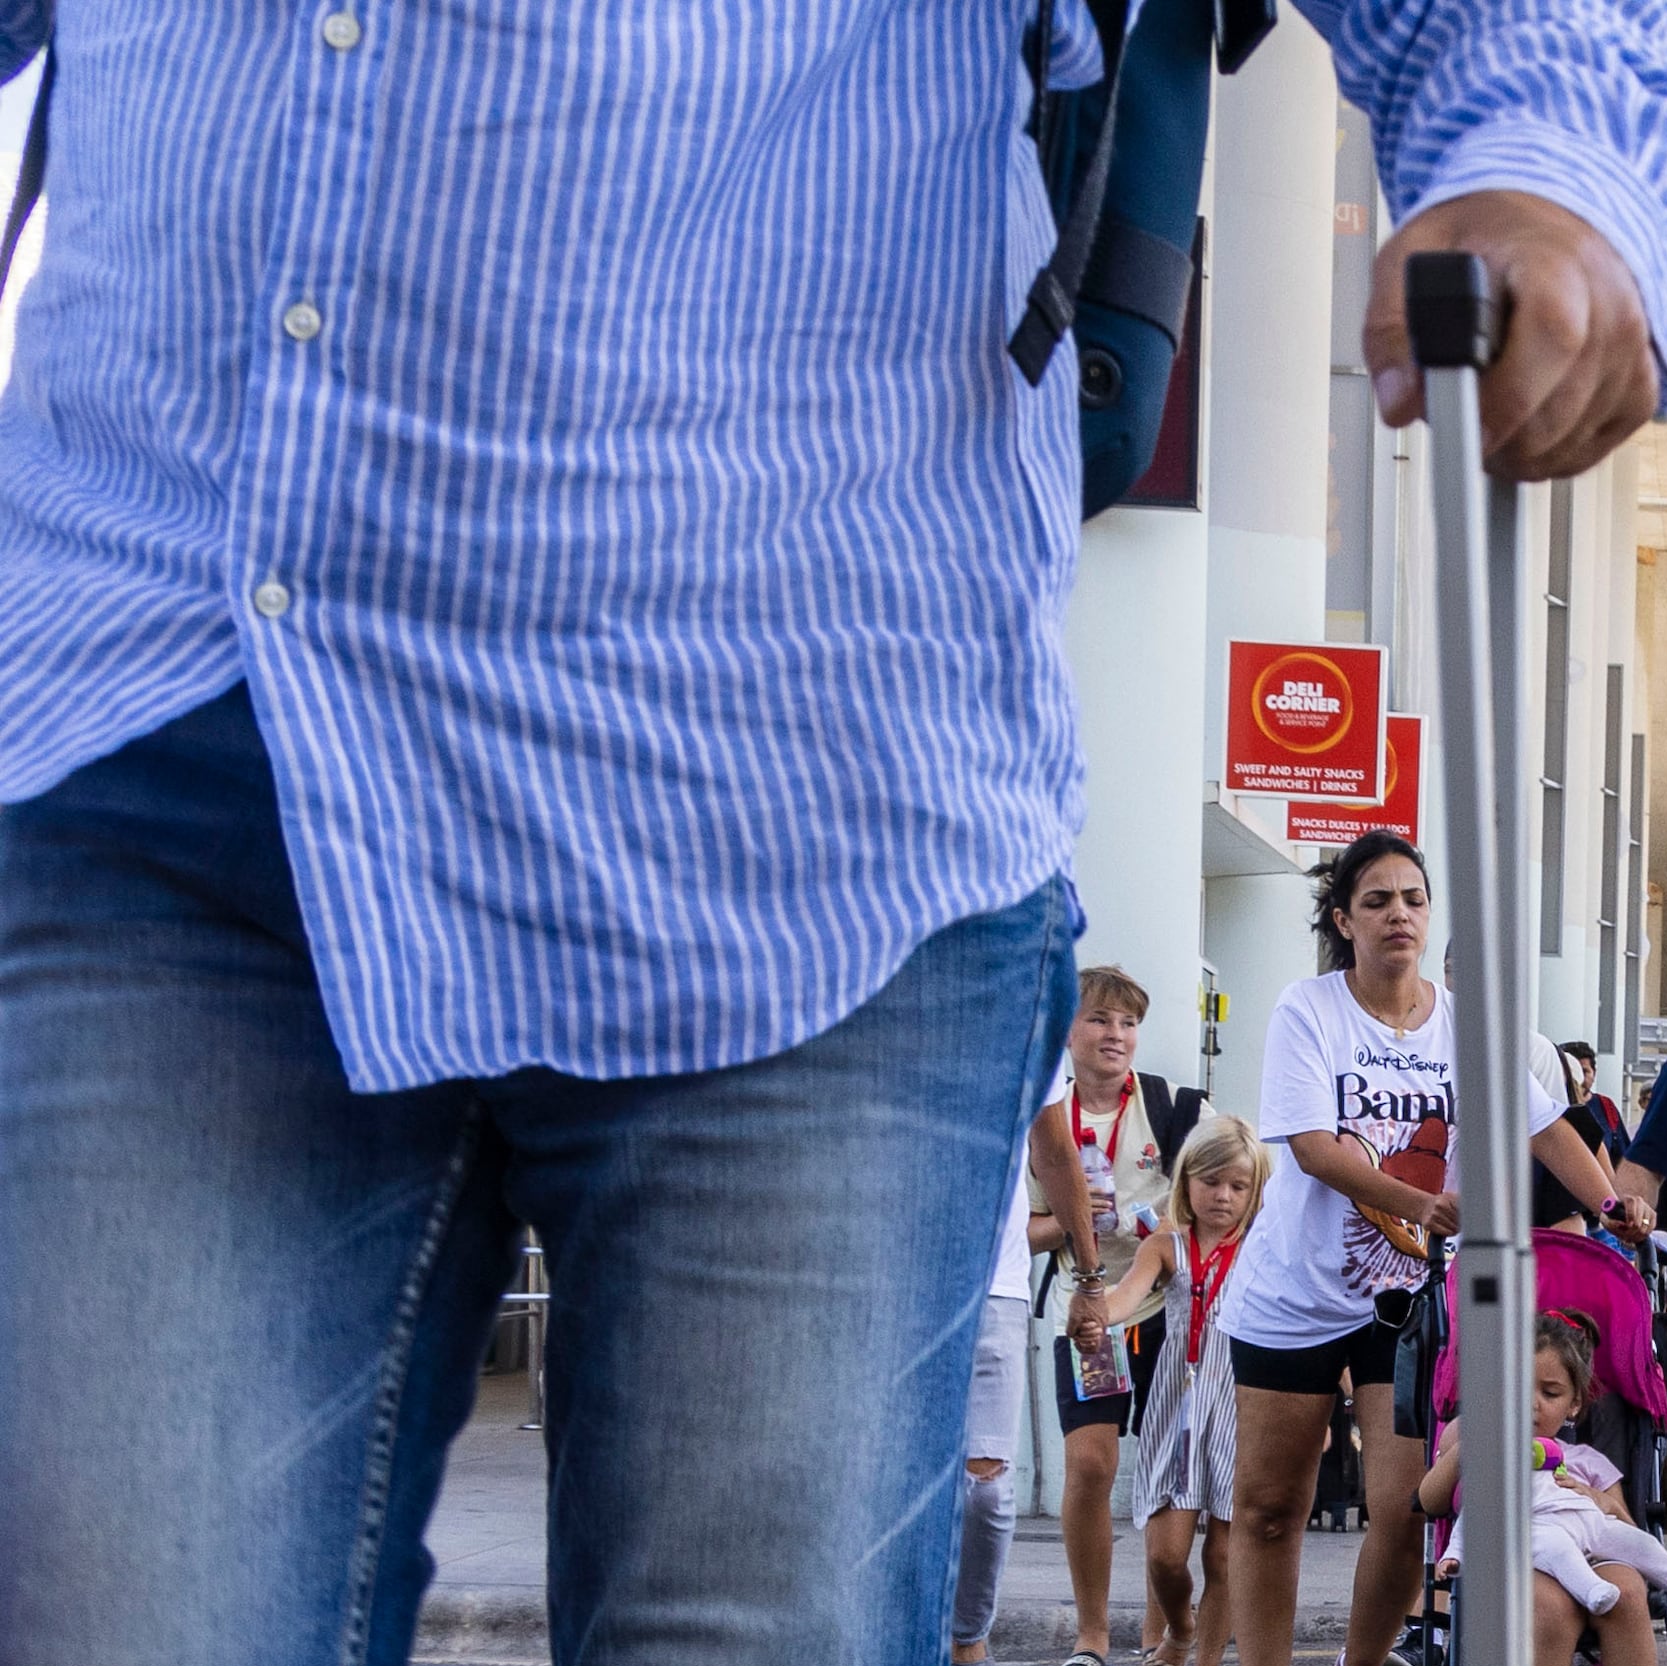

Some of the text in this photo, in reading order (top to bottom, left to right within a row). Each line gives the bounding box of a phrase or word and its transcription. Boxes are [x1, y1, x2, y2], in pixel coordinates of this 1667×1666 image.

[1282, 680, 1324, 698] DELI
[1265, 694, 1341, 714] CORNER
[1234, 763, 1365, 780] SWEET AND SALTY SNACKS
[1243, 777, 1358, 793] SANDWICHES DRINKS
[1291, 816, 1328, 829] SNACKS
[1328, 818, 1361, 832] DULCES
[1361, 821, 1370, 832] Y
[1299, 829, 1358, 842] SANDWICHES
